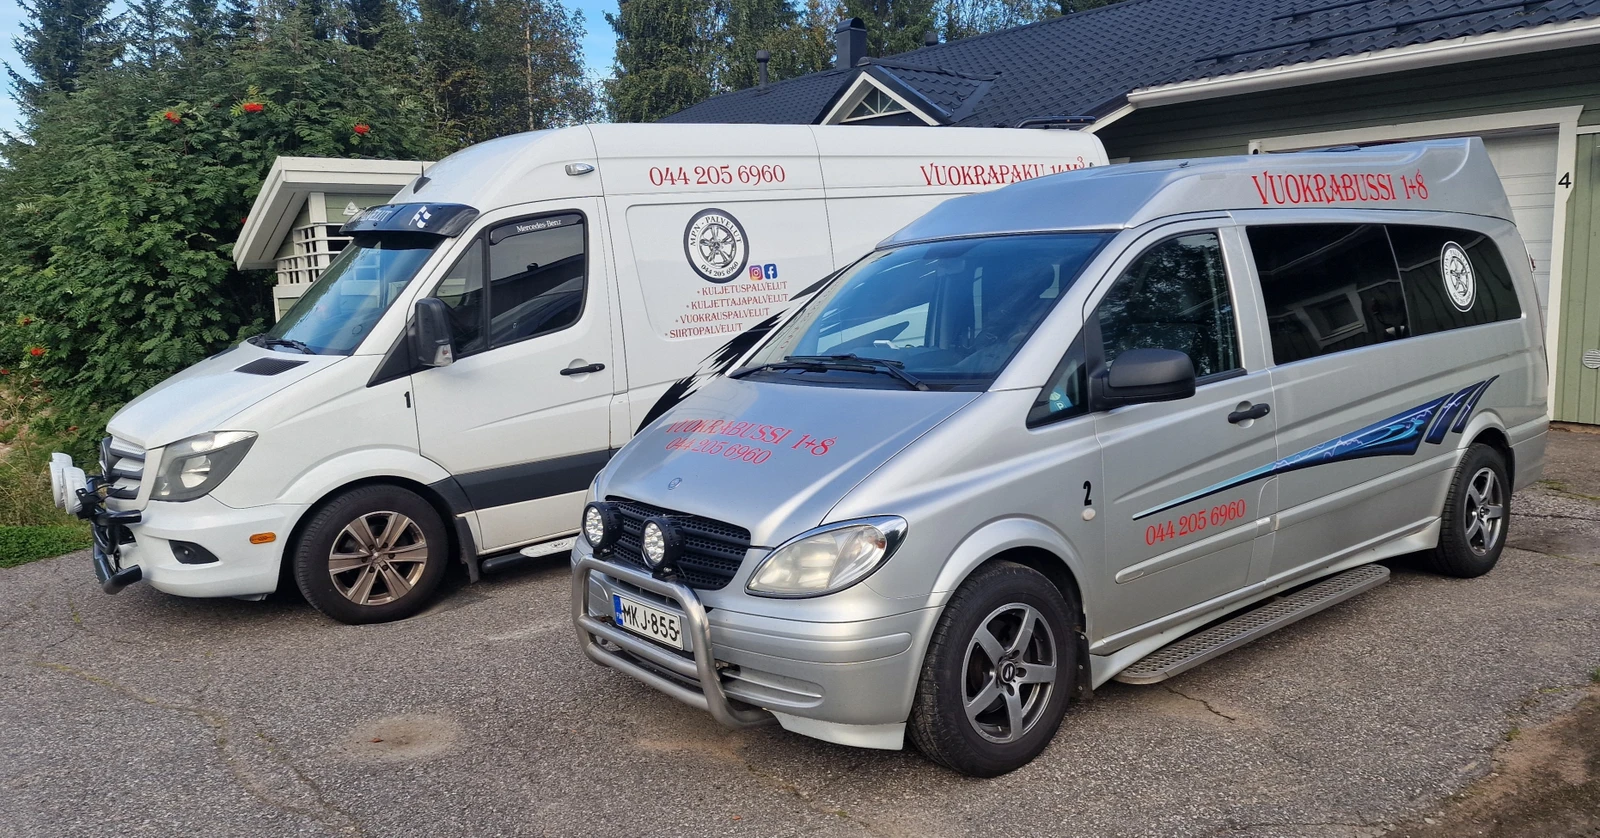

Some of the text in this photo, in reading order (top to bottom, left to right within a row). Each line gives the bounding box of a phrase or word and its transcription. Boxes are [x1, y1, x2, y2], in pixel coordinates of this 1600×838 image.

[649, 163, 786, 187] 044 205 6960
[919, 162, 1046, 187] VUOKRAPAKU
[1251, 168, 1429, 205] VUOKRABUSSI 1+8
[1558, 171, 1572, 189] 4
[515, 219, 562, 233] Mercedes-Benz
[689, 215, 743, 247] MPN PALVELUT
[700, 263, 713, 275] 044
[701, 281, 788, 296] KULJETUSPALVELUT
[690, 293, 789, 310] KULJETTAJAPALVELUT
[679, 307, 770, 324] VUOKRAUSPALVELUT
[669, 323, 743, 339] SIIRTOPALVELUT
[403, 391, 412, 409] 1
[665, 436, 773, 465] 044 205 6960
[791, 433, 839, 457] 1+8
[1082, 480, 1093, 507] 2
[1145, 498, 1247, 546] 044 205 6960
[622, 603, 678, 642] MKJ-855
